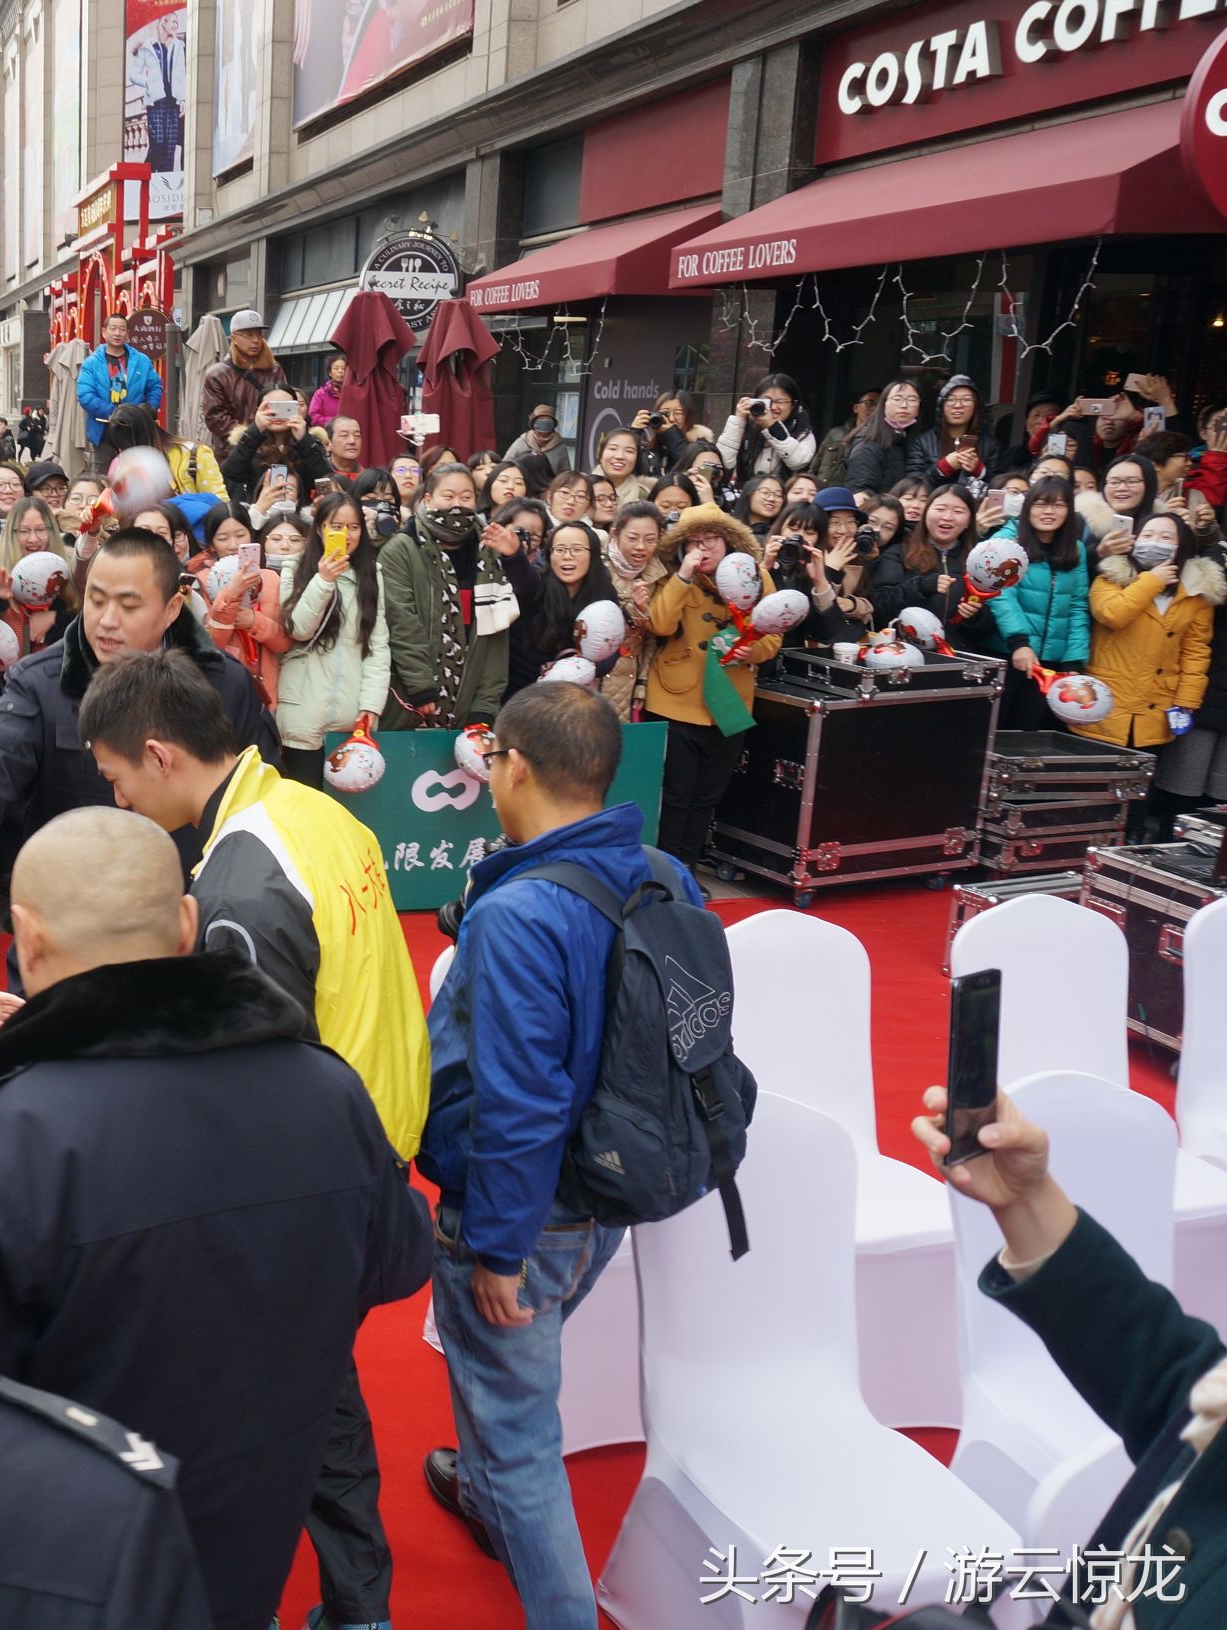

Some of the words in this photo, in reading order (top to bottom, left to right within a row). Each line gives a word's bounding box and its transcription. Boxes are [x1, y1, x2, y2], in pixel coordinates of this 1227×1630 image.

[837, 20, 991, 115] COSTA
[1015, 0, 1227, 63] COF
[149, 193, 184, 203] OSID
[378, 241, 412, 262] CULINARY
[412, 242, 444, 260] JOURNEY
[440, 259, 450, 272] TO
[677, 254, 699, 278] FOR
[702, 247, 745, 275] COFFEE
[747, 238, 797, 269] LOVERS
[410, 276, 450, 295] Recipe
[470, 289, 483, 307] FOR
[485, 285, 510, 305] COFFEE
[511, 280, 540, 302] LOVERS
[594, 380, 620, 399] Cold
[624, 379, 660, 399] hands
[384, 837, 488, 872] 限发展
